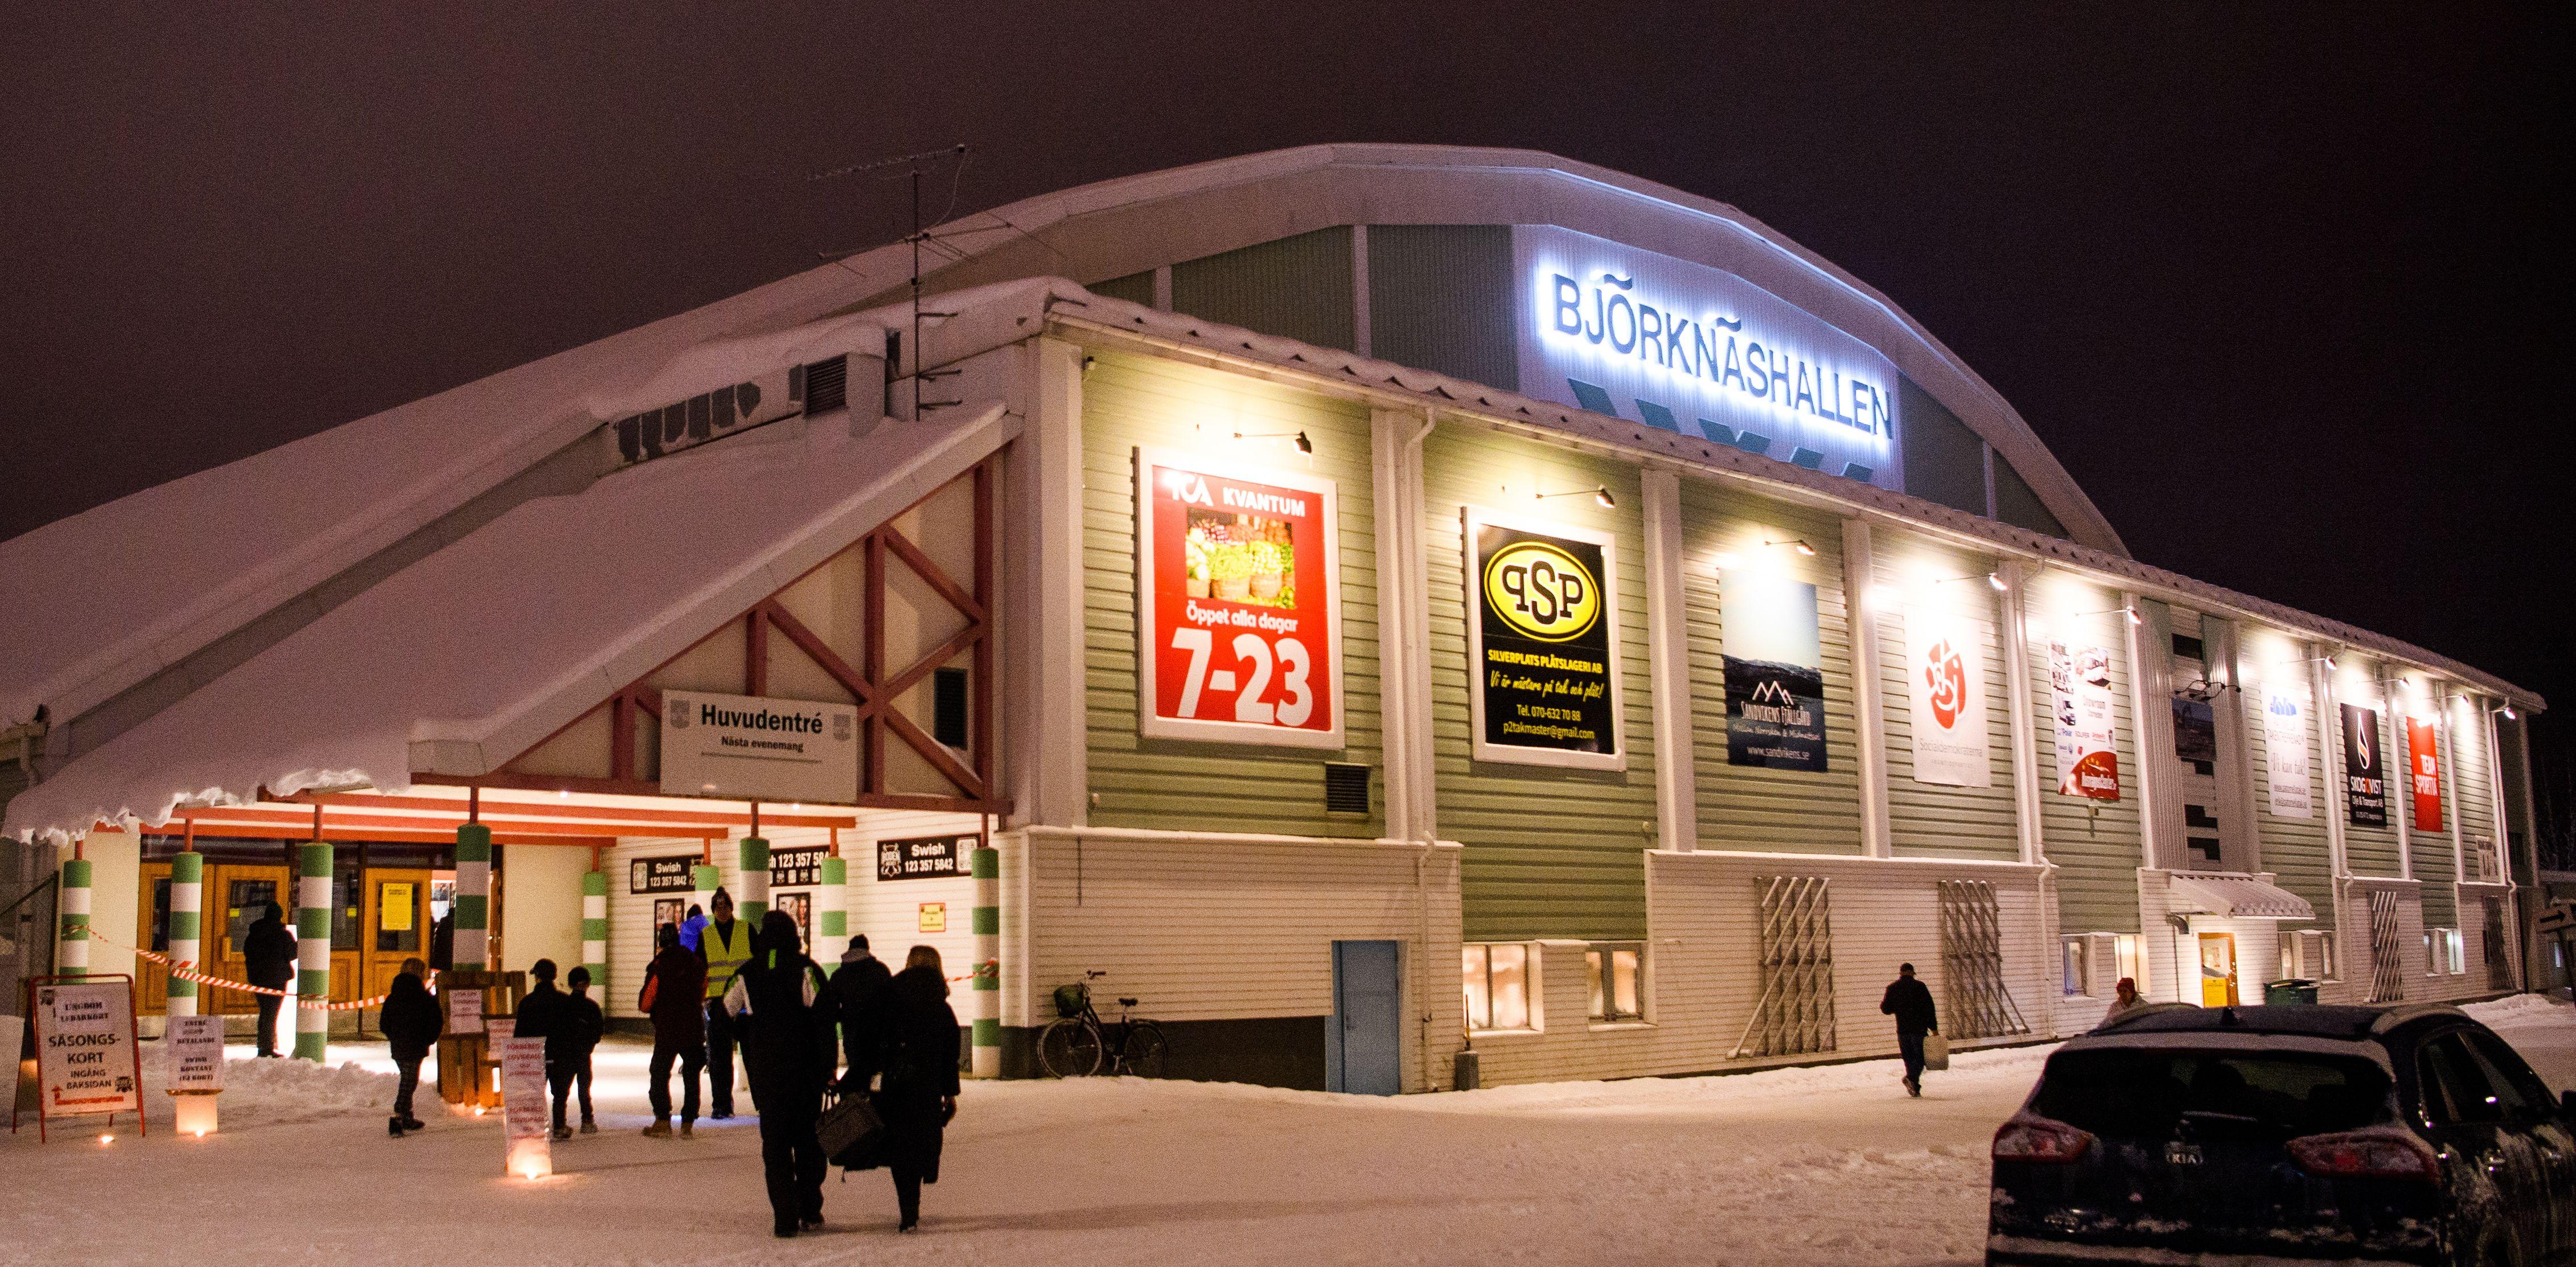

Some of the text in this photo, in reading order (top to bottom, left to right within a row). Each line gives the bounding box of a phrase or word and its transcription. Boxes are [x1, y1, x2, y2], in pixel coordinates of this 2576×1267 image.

[1223, 487, 1305, 517] KVANTUM
[1186, 600, 1298, 634] Öppet alla dagar
[1488, 649, 1603, 674] SILVERPLATS PLÅTSLAGERI AB
[1171, 627, 1313, 727] 7-23
[1490, 670, 1500, 688] Vi
[1501, 674, 1511, 688] är
[1513, 676, 1542, 691] mästare
[1542, 679, 1554, 698] på
[1555, 678, 1570, 694] tak
[1570, 681, 1583, 695] och
[702, 704, 823, 734] Huvudentré
[1517, 704, 1581, 722] Tel. 070-632 70 88
[1741, 701, 1780, 723] SANDVIKENS
[1503, 721, 1595, 740] p2takmaster@gmail.com
[722, 735, 804, 753] Nästa evenemang
[1747, 746, 1810, 760] www.sandvikens.se
[1920, 738, 1983, 758] Socialdemokraterna
[2421, 754, 2437, 776] TEAM
[2350, 776, 2382, 795] SKOGQVIST
[2415, 774, 2438, 797] SPORTIA
[911, 842, 945, 857] Swish
[656, 861, 681, 874] Swish
[778, 854, 794, 868] 123
[796, 852, 811, 867] 357
[905, 858, 954, 872] 123 357 5842
[650, 875, 687, 886] 123 357 5842
[48, 1033, 120, 1047] SÄSONGS-
[67, 1052, 104, 1064] KORT
[70, 1068, 106, 1078] INGÅNG
[67, 1080, 112, 1089] BAKSIDAN
[2172, 1153, 2197, 1164] KIA
